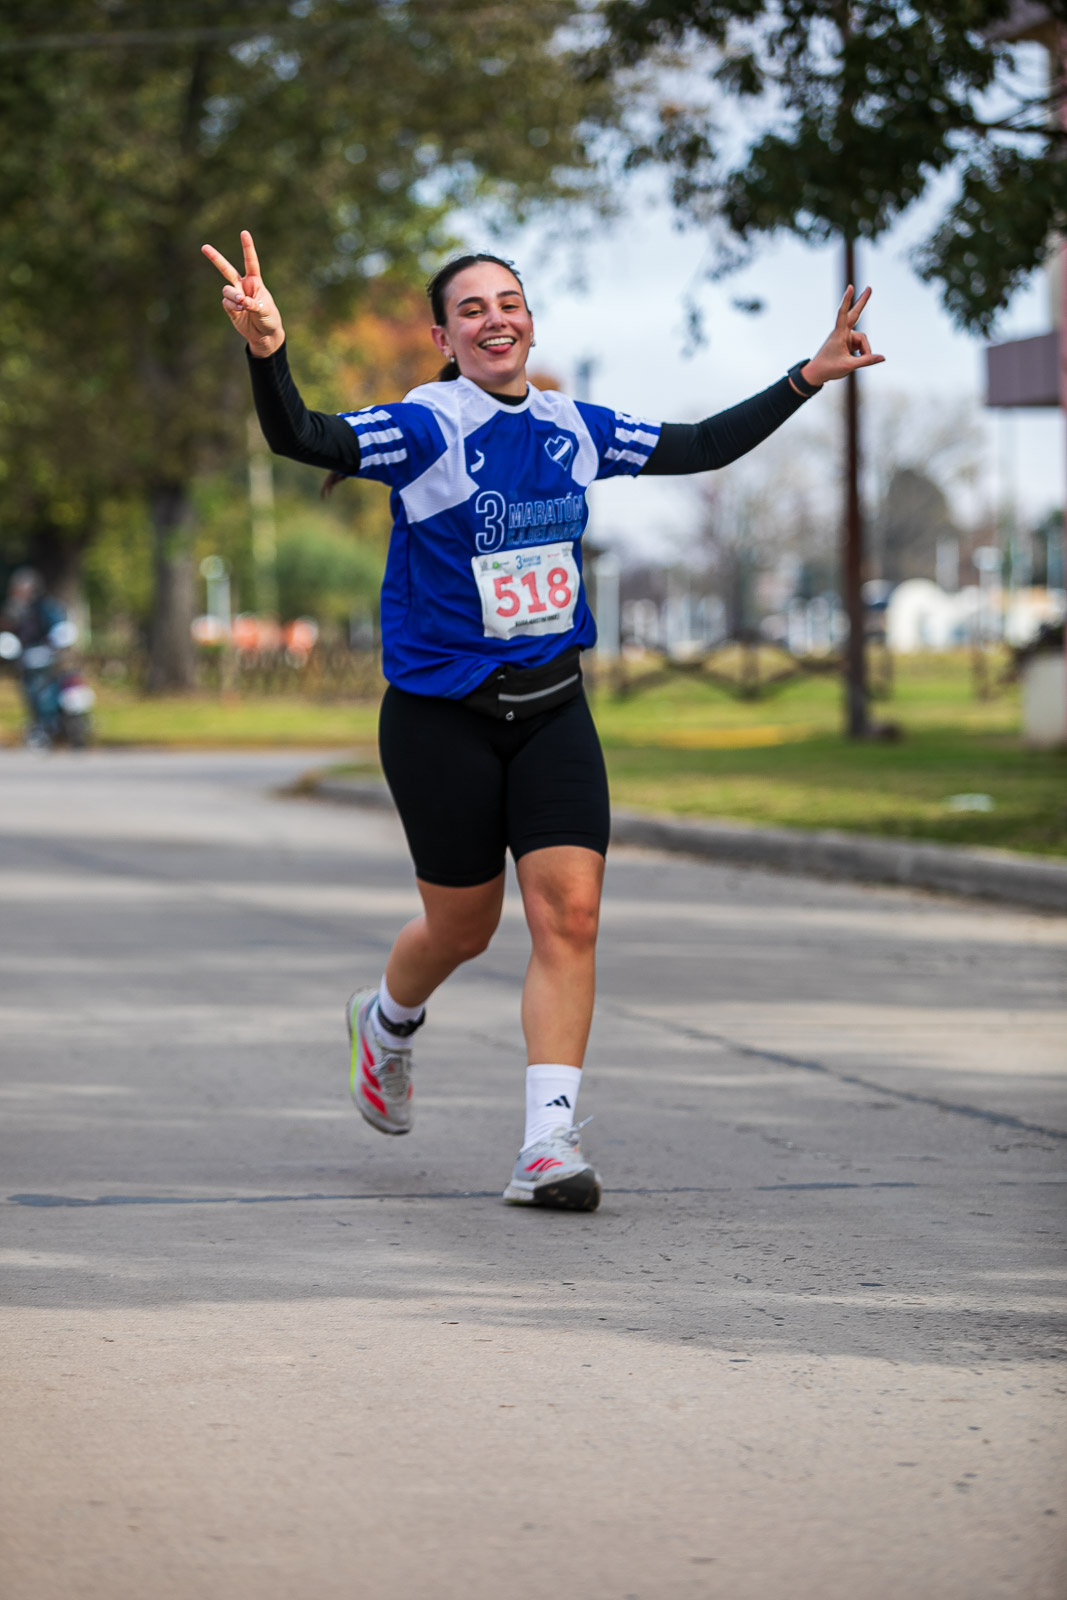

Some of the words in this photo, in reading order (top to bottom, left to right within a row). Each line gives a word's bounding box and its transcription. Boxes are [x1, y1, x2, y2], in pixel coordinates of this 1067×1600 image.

[475, 491, 506, 553] 3
[508, 492, 583, 529] MARATÓN
[515, 555, 524, 570] 3
[493, 567, 572, 617] 518
